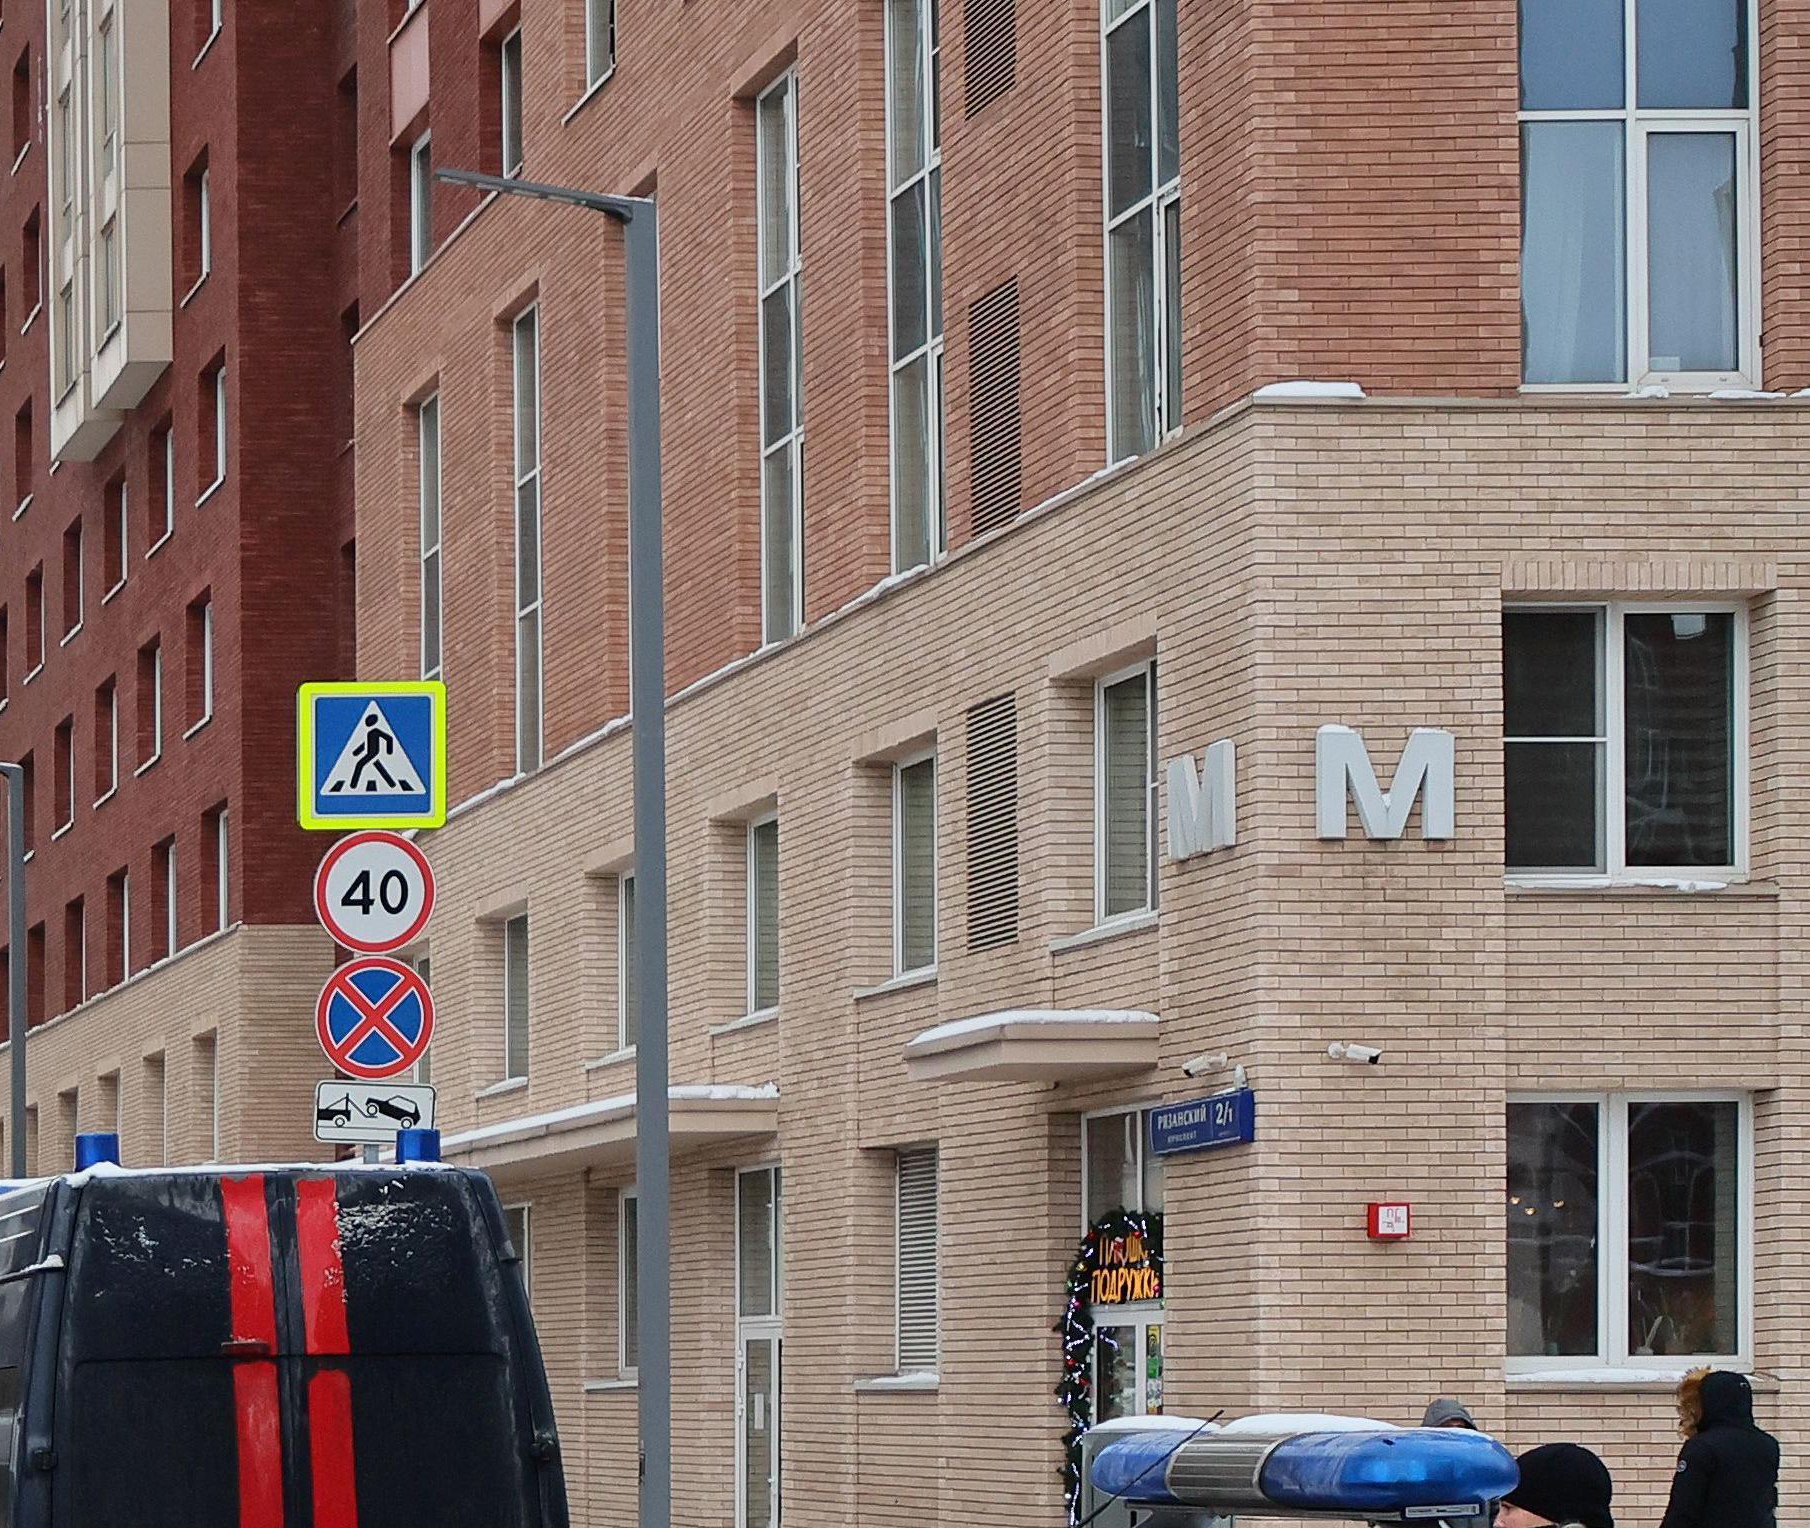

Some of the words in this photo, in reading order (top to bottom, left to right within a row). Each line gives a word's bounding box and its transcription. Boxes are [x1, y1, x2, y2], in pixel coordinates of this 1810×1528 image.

[1316, 725, 1455, 839] M
[341, 869, 408, 915] 40
[1157, 1103, 1207, 1130] РЯЗАНСКИЙ
